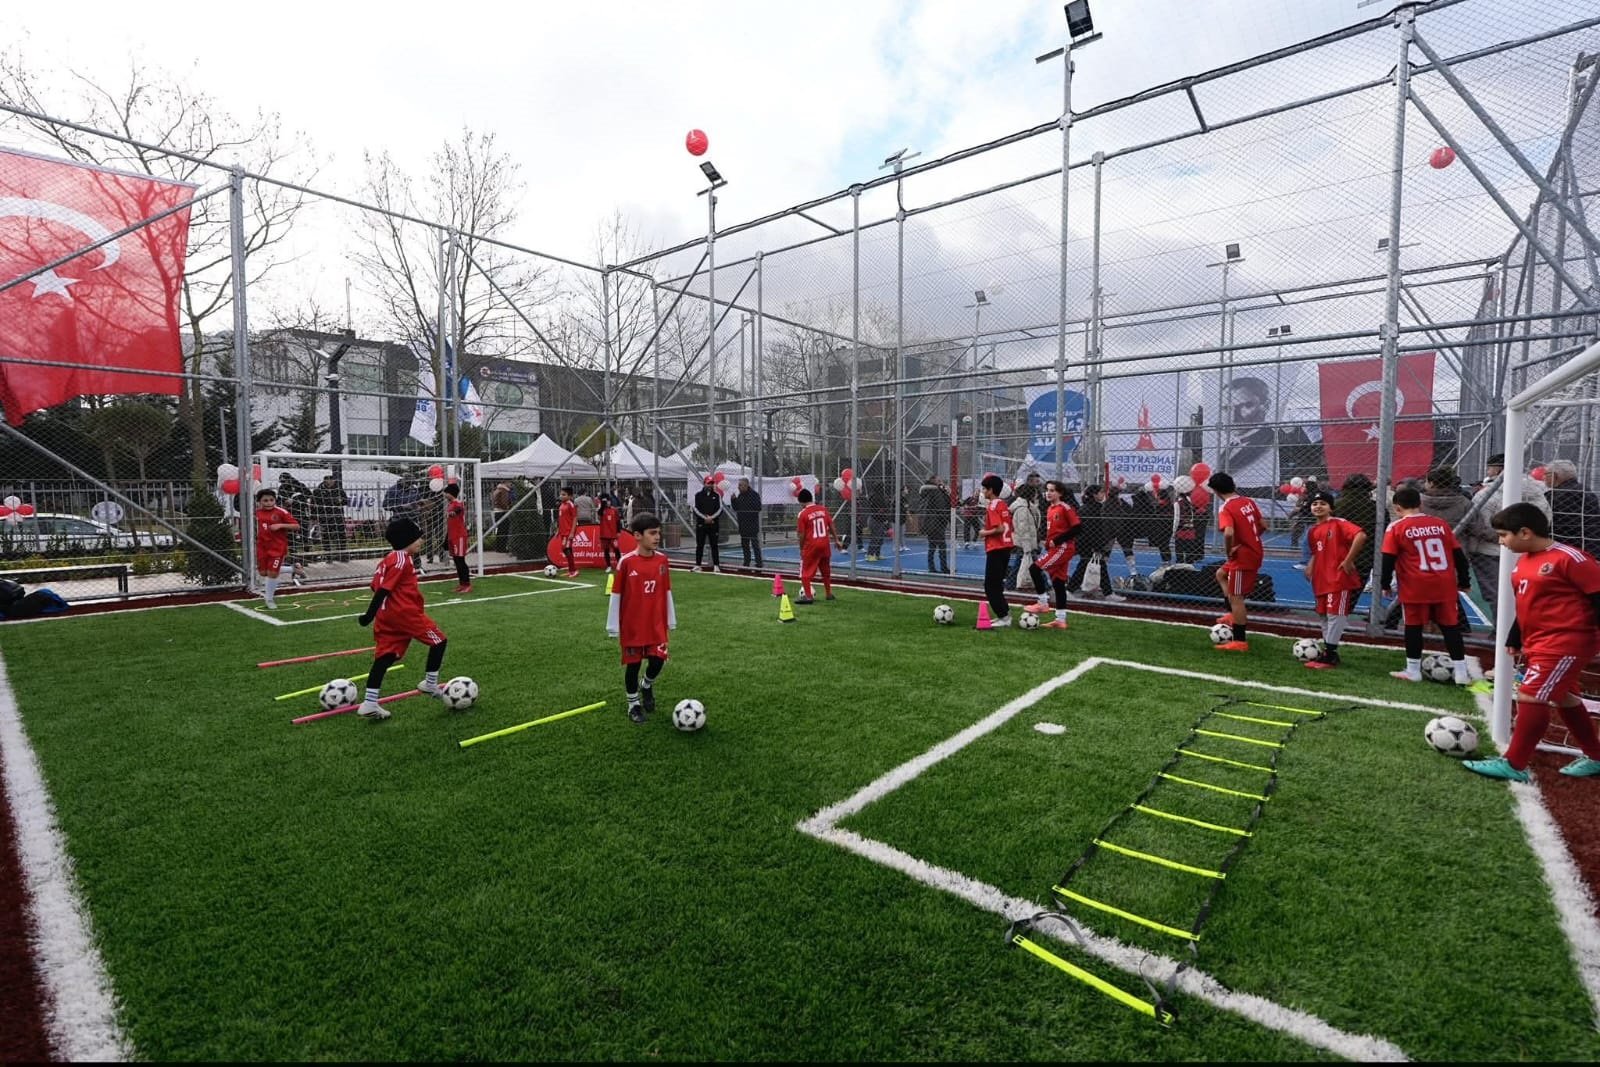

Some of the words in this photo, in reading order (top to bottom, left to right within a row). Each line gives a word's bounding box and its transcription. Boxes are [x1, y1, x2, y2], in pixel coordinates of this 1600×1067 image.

[812, 517, 827, 539] 10
[1405, 525, 1445, 538] GÖRKEM
[1316, 540, 1323, 551] 8
[1413, 538, 1449, 571] 19
[643, 580, 656, 594] 27
